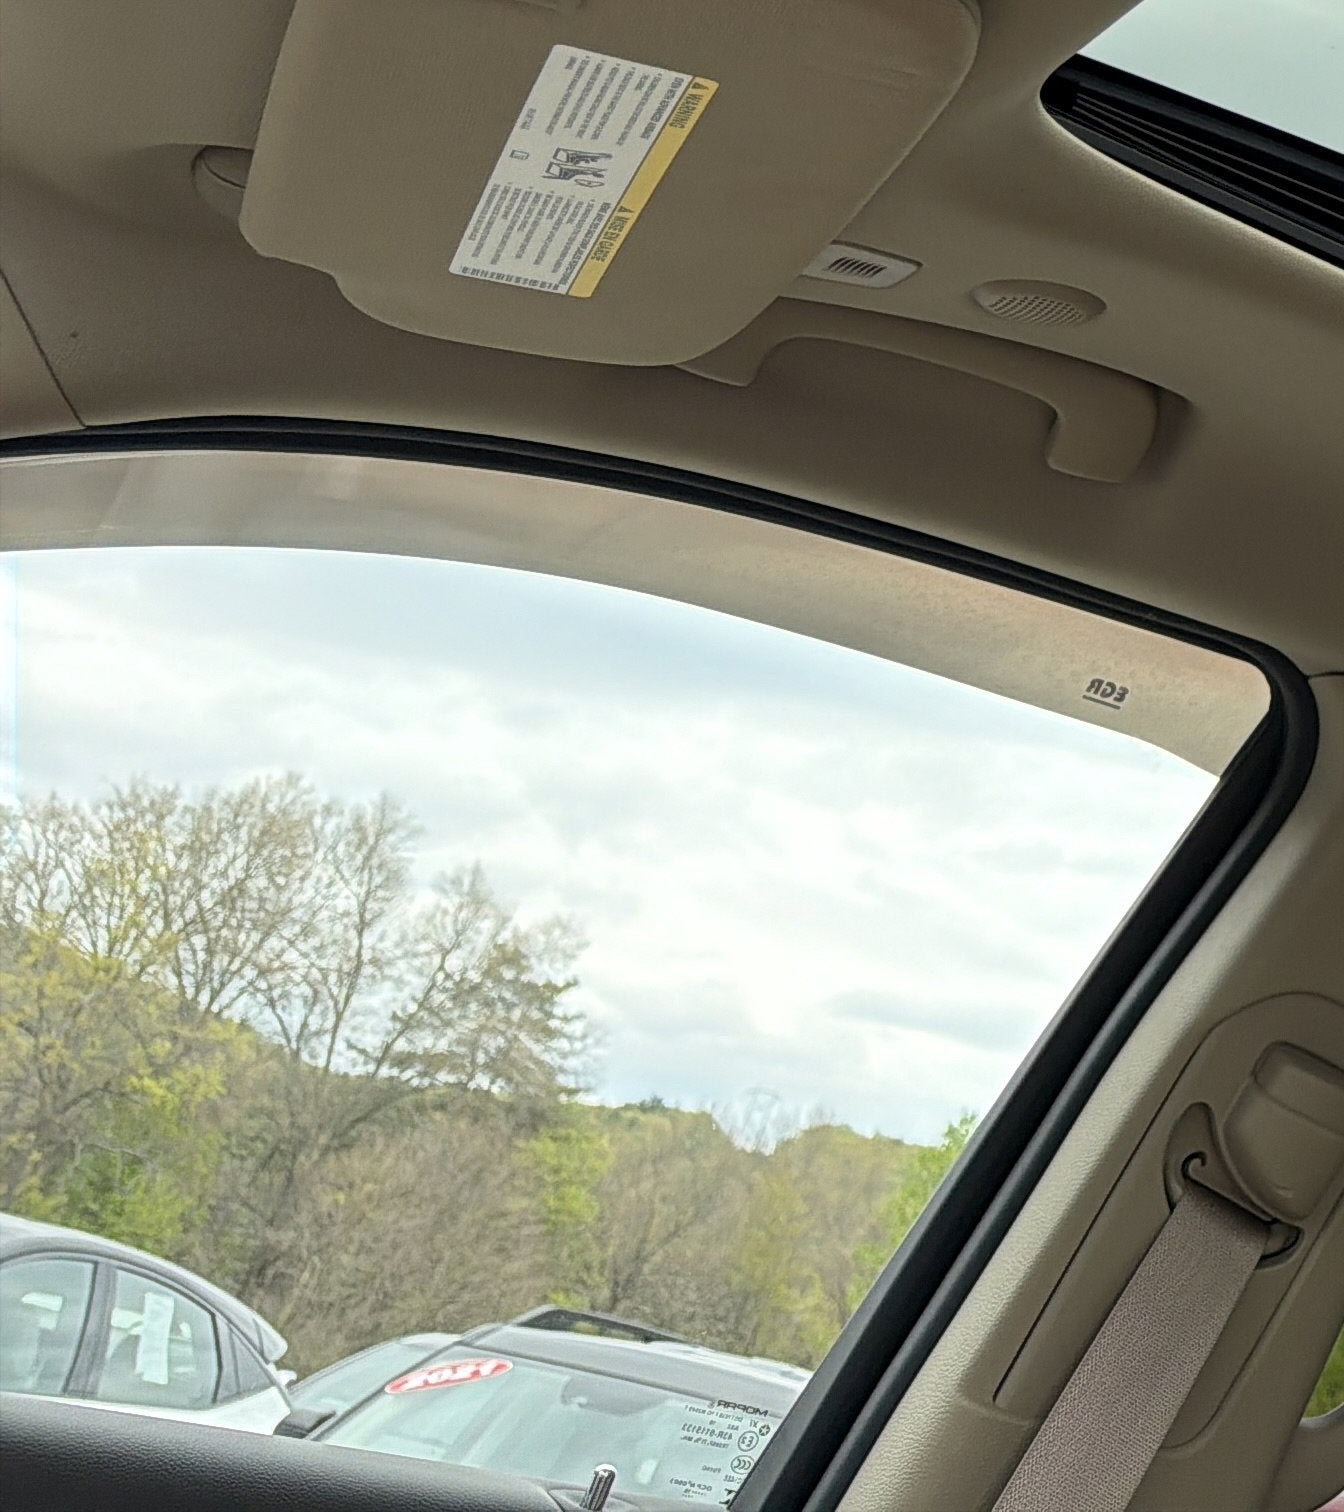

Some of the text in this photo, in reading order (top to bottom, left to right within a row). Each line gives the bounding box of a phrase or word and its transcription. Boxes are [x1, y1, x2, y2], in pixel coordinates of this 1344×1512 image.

[668, 91, 704, 129] WARNING
[589, 215, 629, 262] MISE EN GARDE
